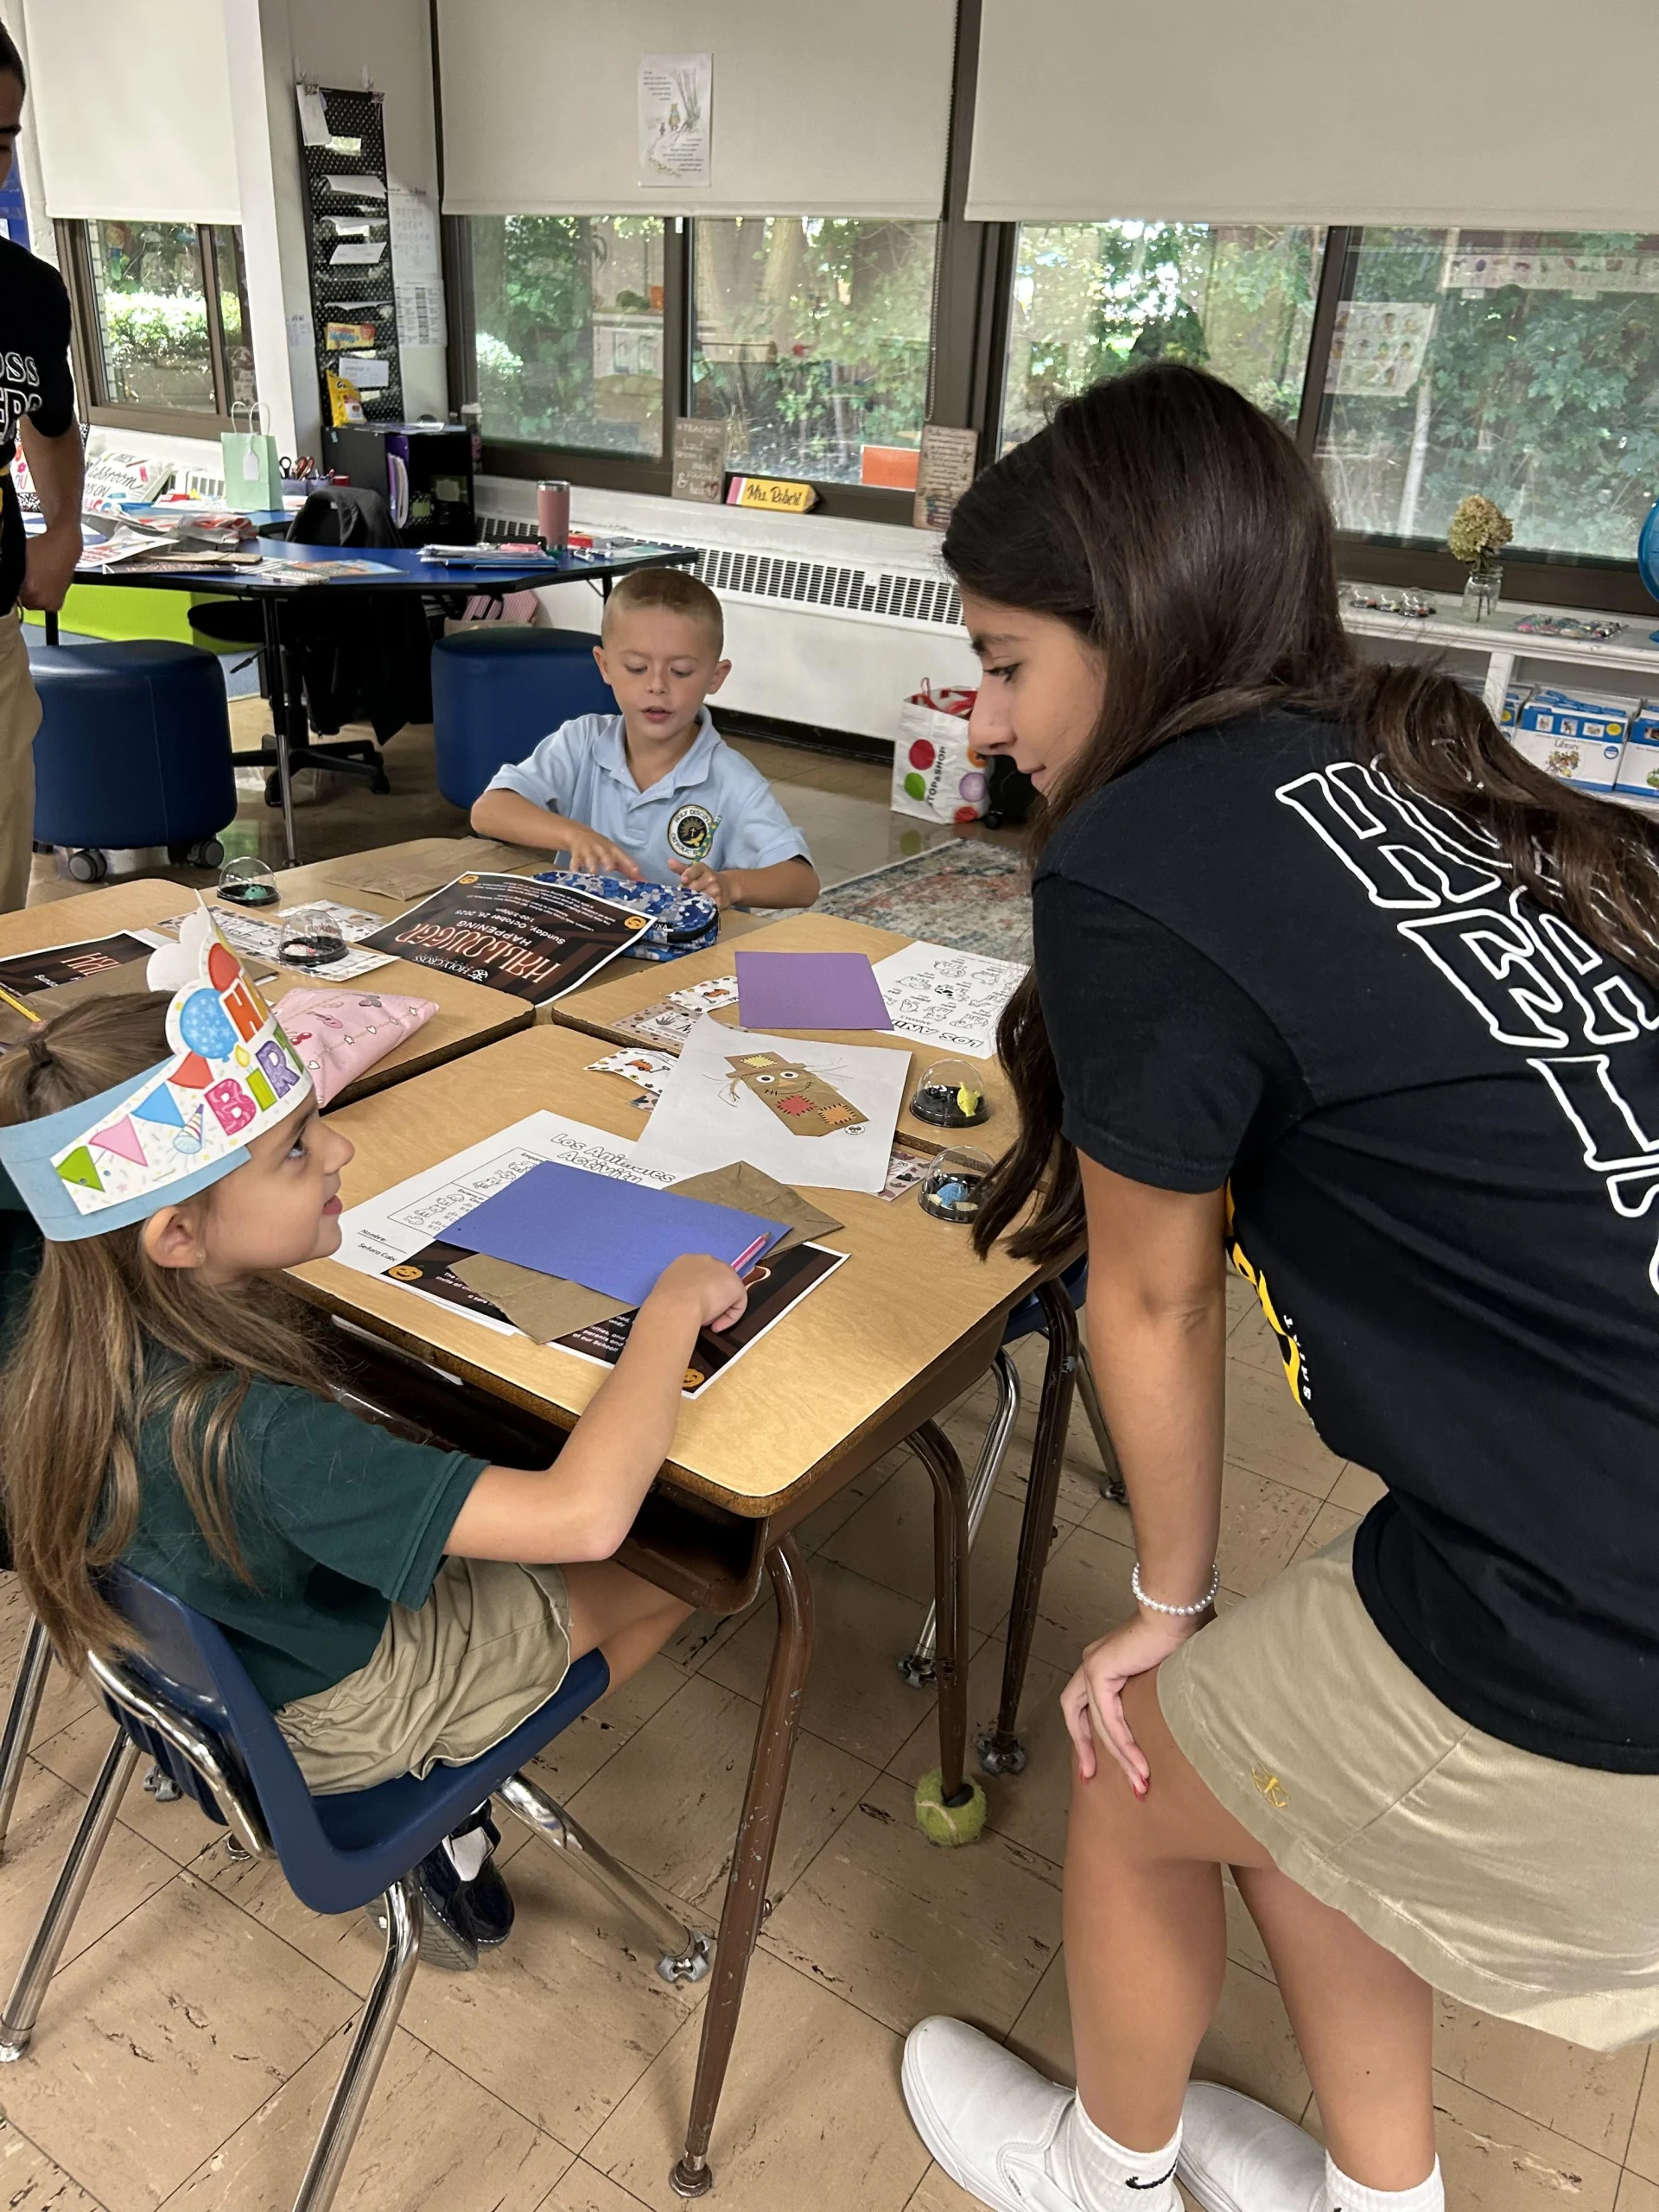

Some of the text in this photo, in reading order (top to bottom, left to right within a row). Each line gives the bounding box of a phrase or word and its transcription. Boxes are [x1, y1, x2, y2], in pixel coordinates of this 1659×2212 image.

[491, 914, 527, 929] October
[456, 920, 532, 947] HAPPENING
[531, 925, 566, 944] Sunday,
[938, 1032, 984, 1048] LOS
[550, 1133, 587, 1151] Los
[582, 1329, 624, 1347] parents and
